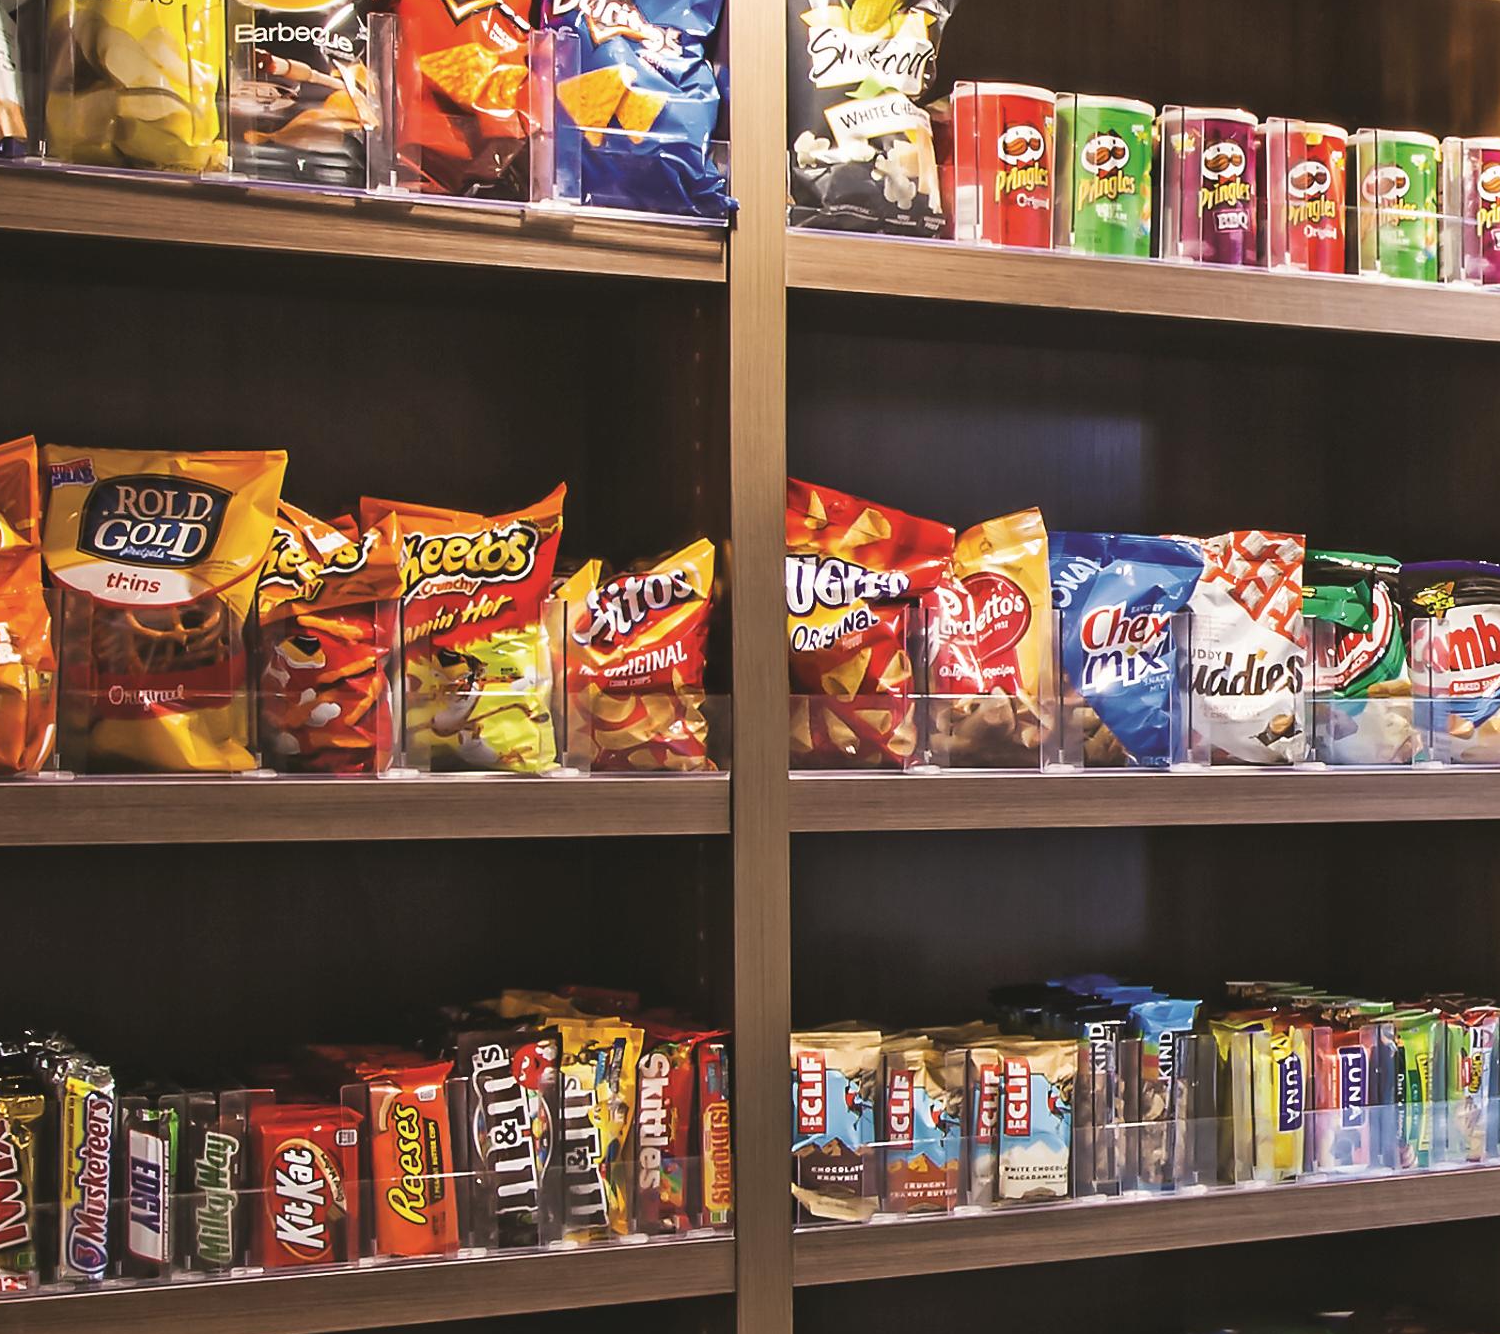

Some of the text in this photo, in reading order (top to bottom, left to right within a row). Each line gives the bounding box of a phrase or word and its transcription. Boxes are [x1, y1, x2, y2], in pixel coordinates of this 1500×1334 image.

[994, 163, 1050, 203] Pringles
[1076, 172, 1137, 211] Pringles
[1198, 180, 1252, 218] Pringles
[1216, 211, 1249, 230] BBQ
[115, 485, 213, 521] ROLD
[93, 517, 208, 559] GOLD
[106, 570, 161, 595] thins
[419, 577, 480, 596] Crunchy
[1082, 601, 1167, 650] Chex
[1157, 1031, 1173, 1080] KIND
[801, 1055, 824, 1115] CLIF
[890, 1074, 912, 1133] CLIF
[1008, 1061, 1028, 1119] CLIF
[1284, 1054, 1301, 1124] LUNA
[1346, 1052, 1363, 1122] LUNA
[638, 1052, 671, 1190] Skittles
[801, 1116, 823, 1127] BAR
[1007, 1119, 1028, 1130] BAR
[74, 1097, 113, 1244] Musketeers
[386, 1103, 427, 1225] Reese's
[194, 1131, 239, 1263] Milky Way
